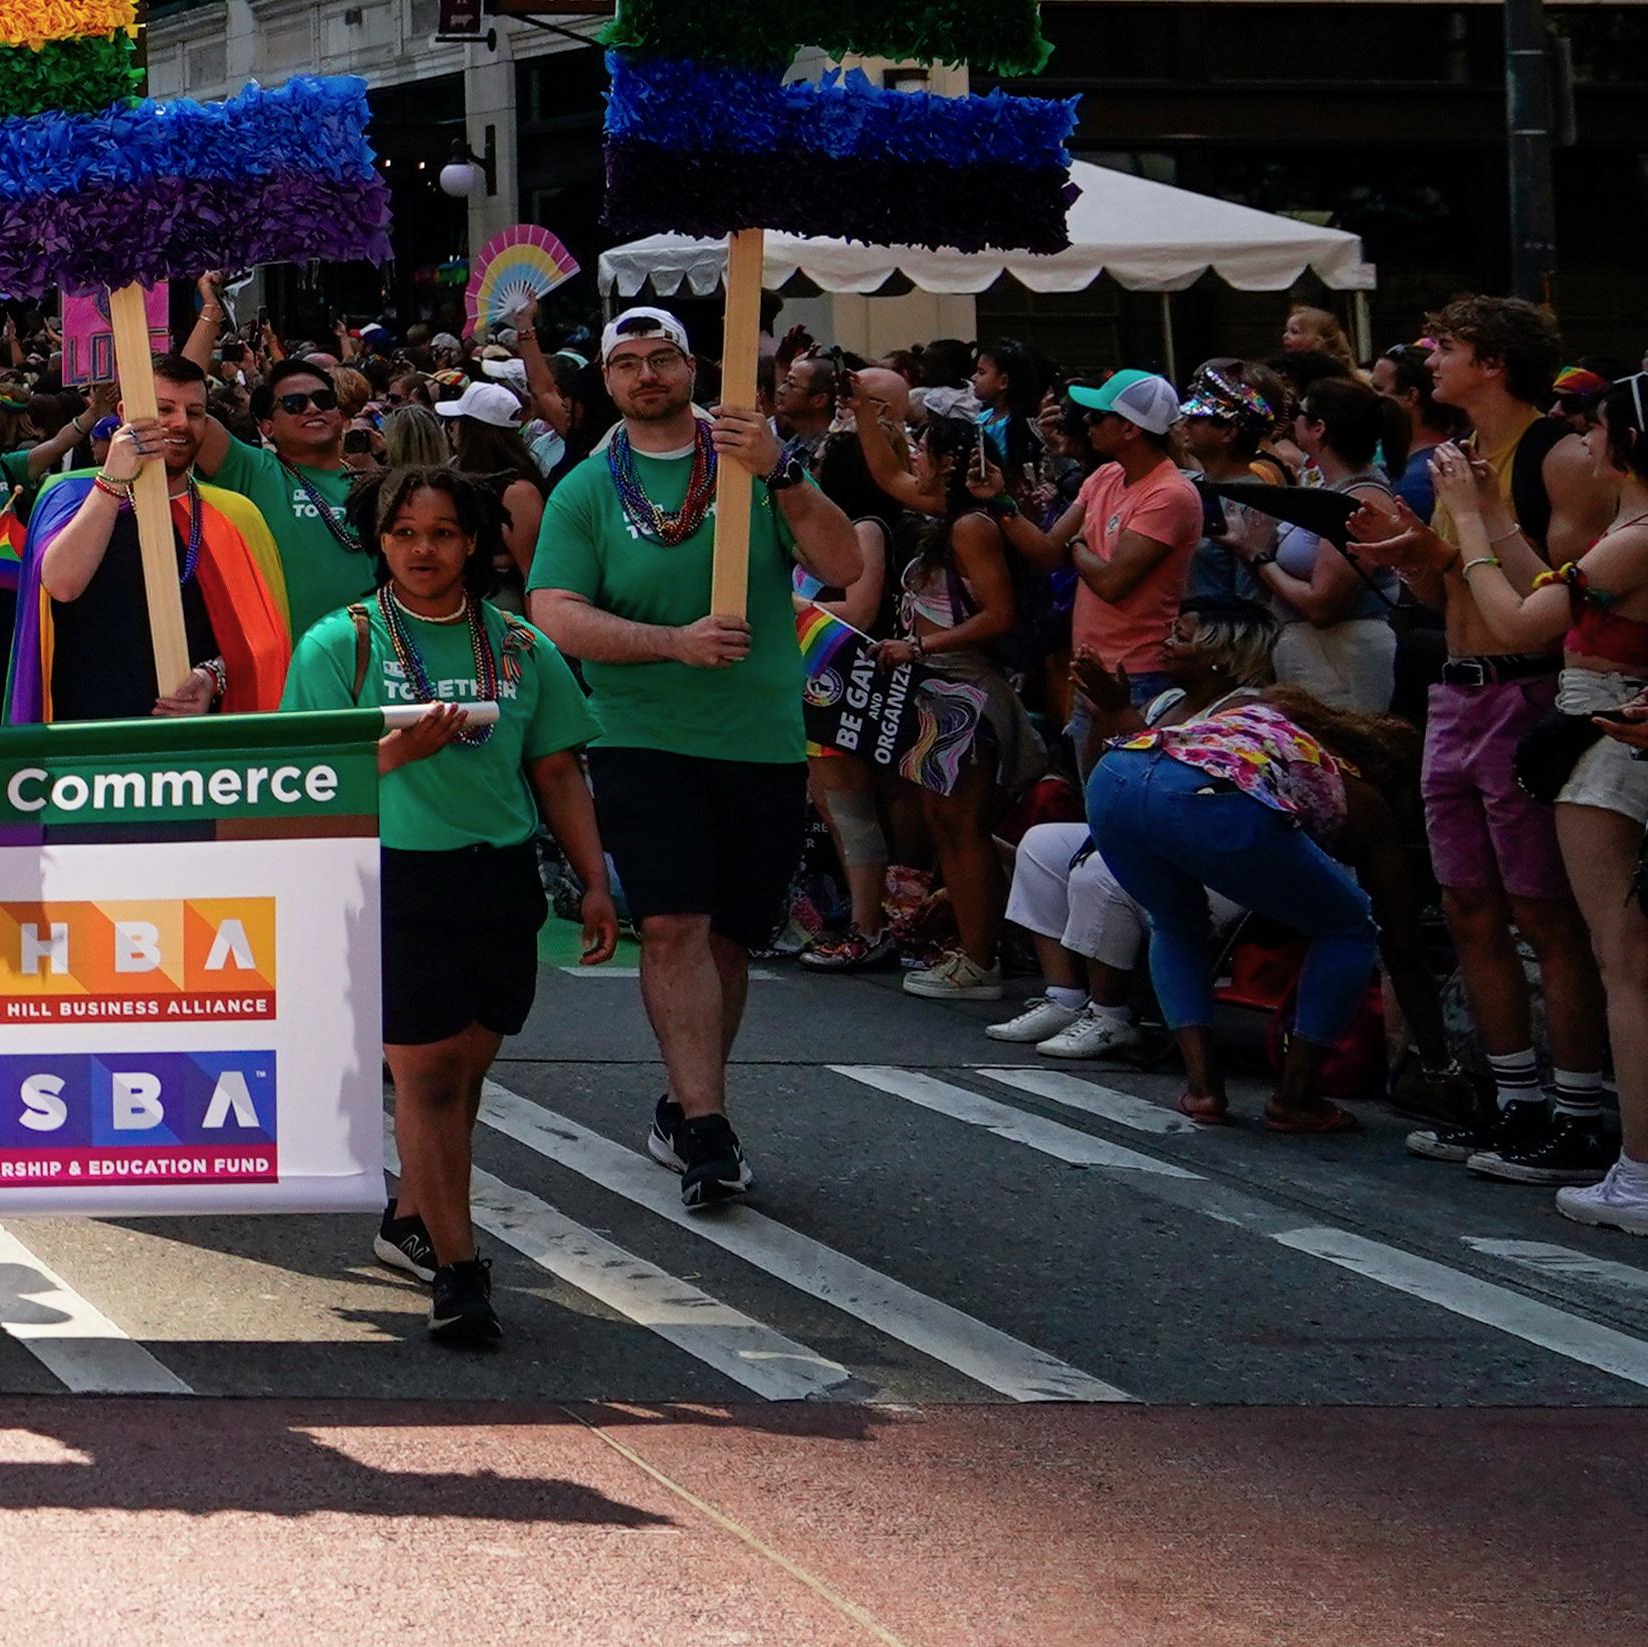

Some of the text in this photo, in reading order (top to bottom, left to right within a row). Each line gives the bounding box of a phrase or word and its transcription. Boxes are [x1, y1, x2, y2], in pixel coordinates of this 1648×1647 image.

[835, 647, 876, 751] BE GAY
[868, 692, 884, 721] AND
[874, 663, 912, 765] ORGANIZE
[8, 764, 340, 814] Commerce
[7, 1002, 53, 1018] HILL
[59, 1000, 160, 1016] BUSINESS
[167, 998, 268, 1015] ALLIANCE
[68, 1160, 82, 1178] &
[88, 1158, 208, 1177] EDUCATION
[213, 1157, 270, 1175] FUND
